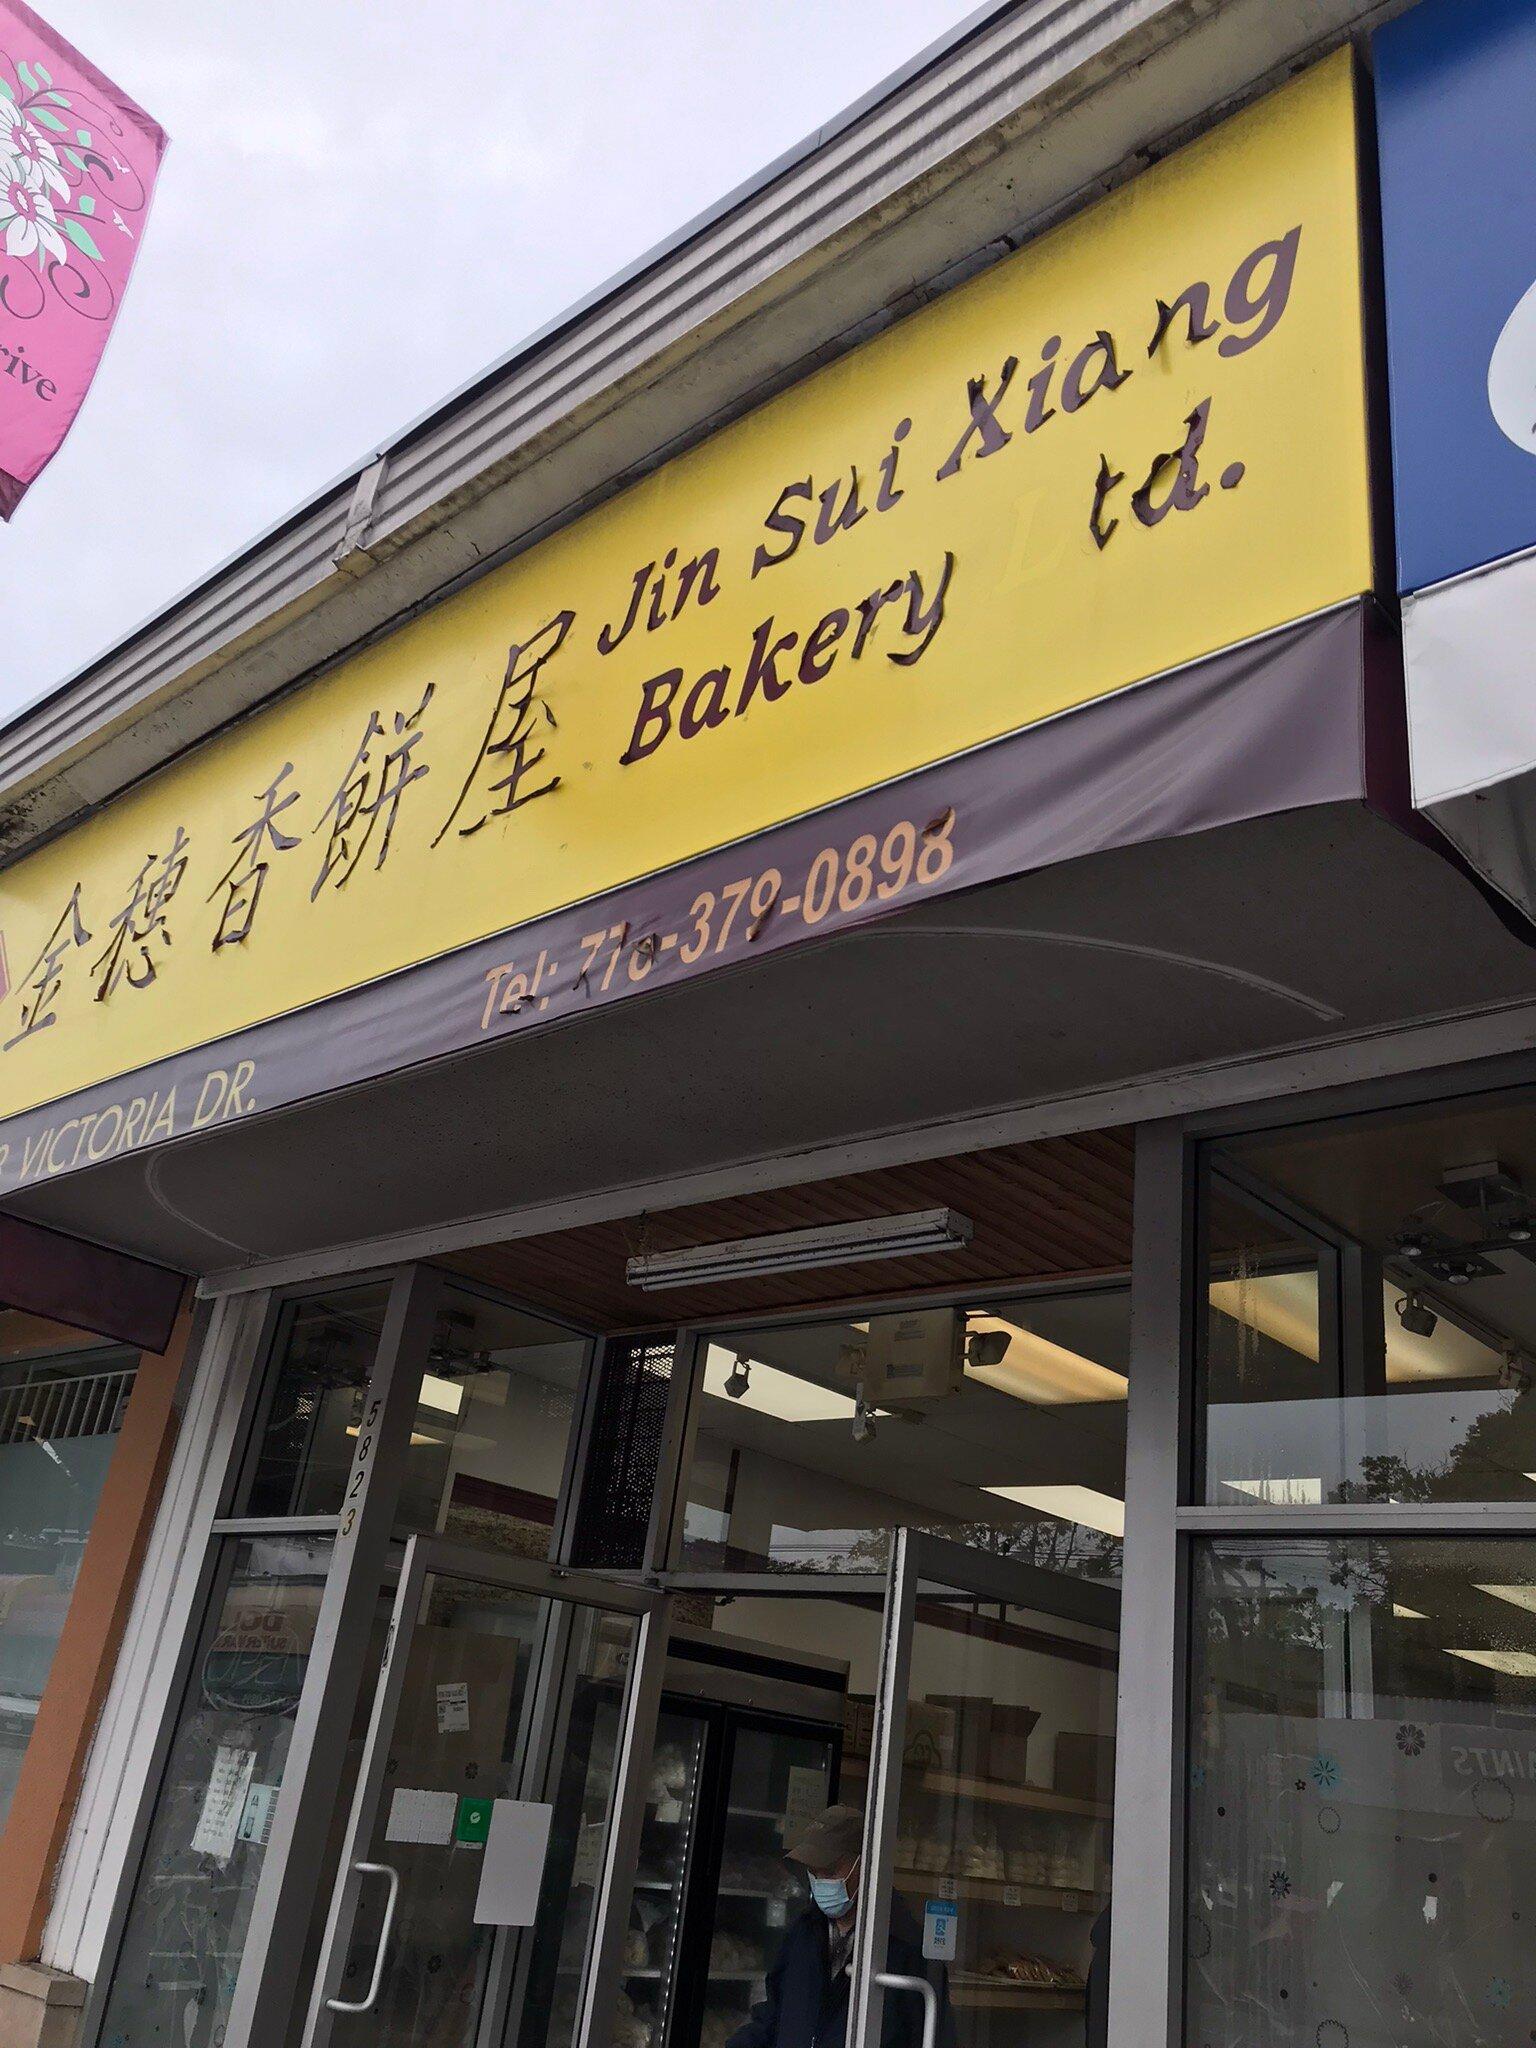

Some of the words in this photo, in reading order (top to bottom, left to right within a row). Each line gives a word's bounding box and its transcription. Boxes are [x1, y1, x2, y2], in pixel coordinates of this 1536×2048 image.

[597, 548, 721, 656] Jin
[751, 418, 912, 579] Sui
[936, 225, 1303, 481] Xiang
[619, 552, 954, 766] Bakery
[481, 950, 558, 1029] Tel:
[20, 1085, 176, 1180] VICTORIA
[191, 1060, 256, 1128] DR.
